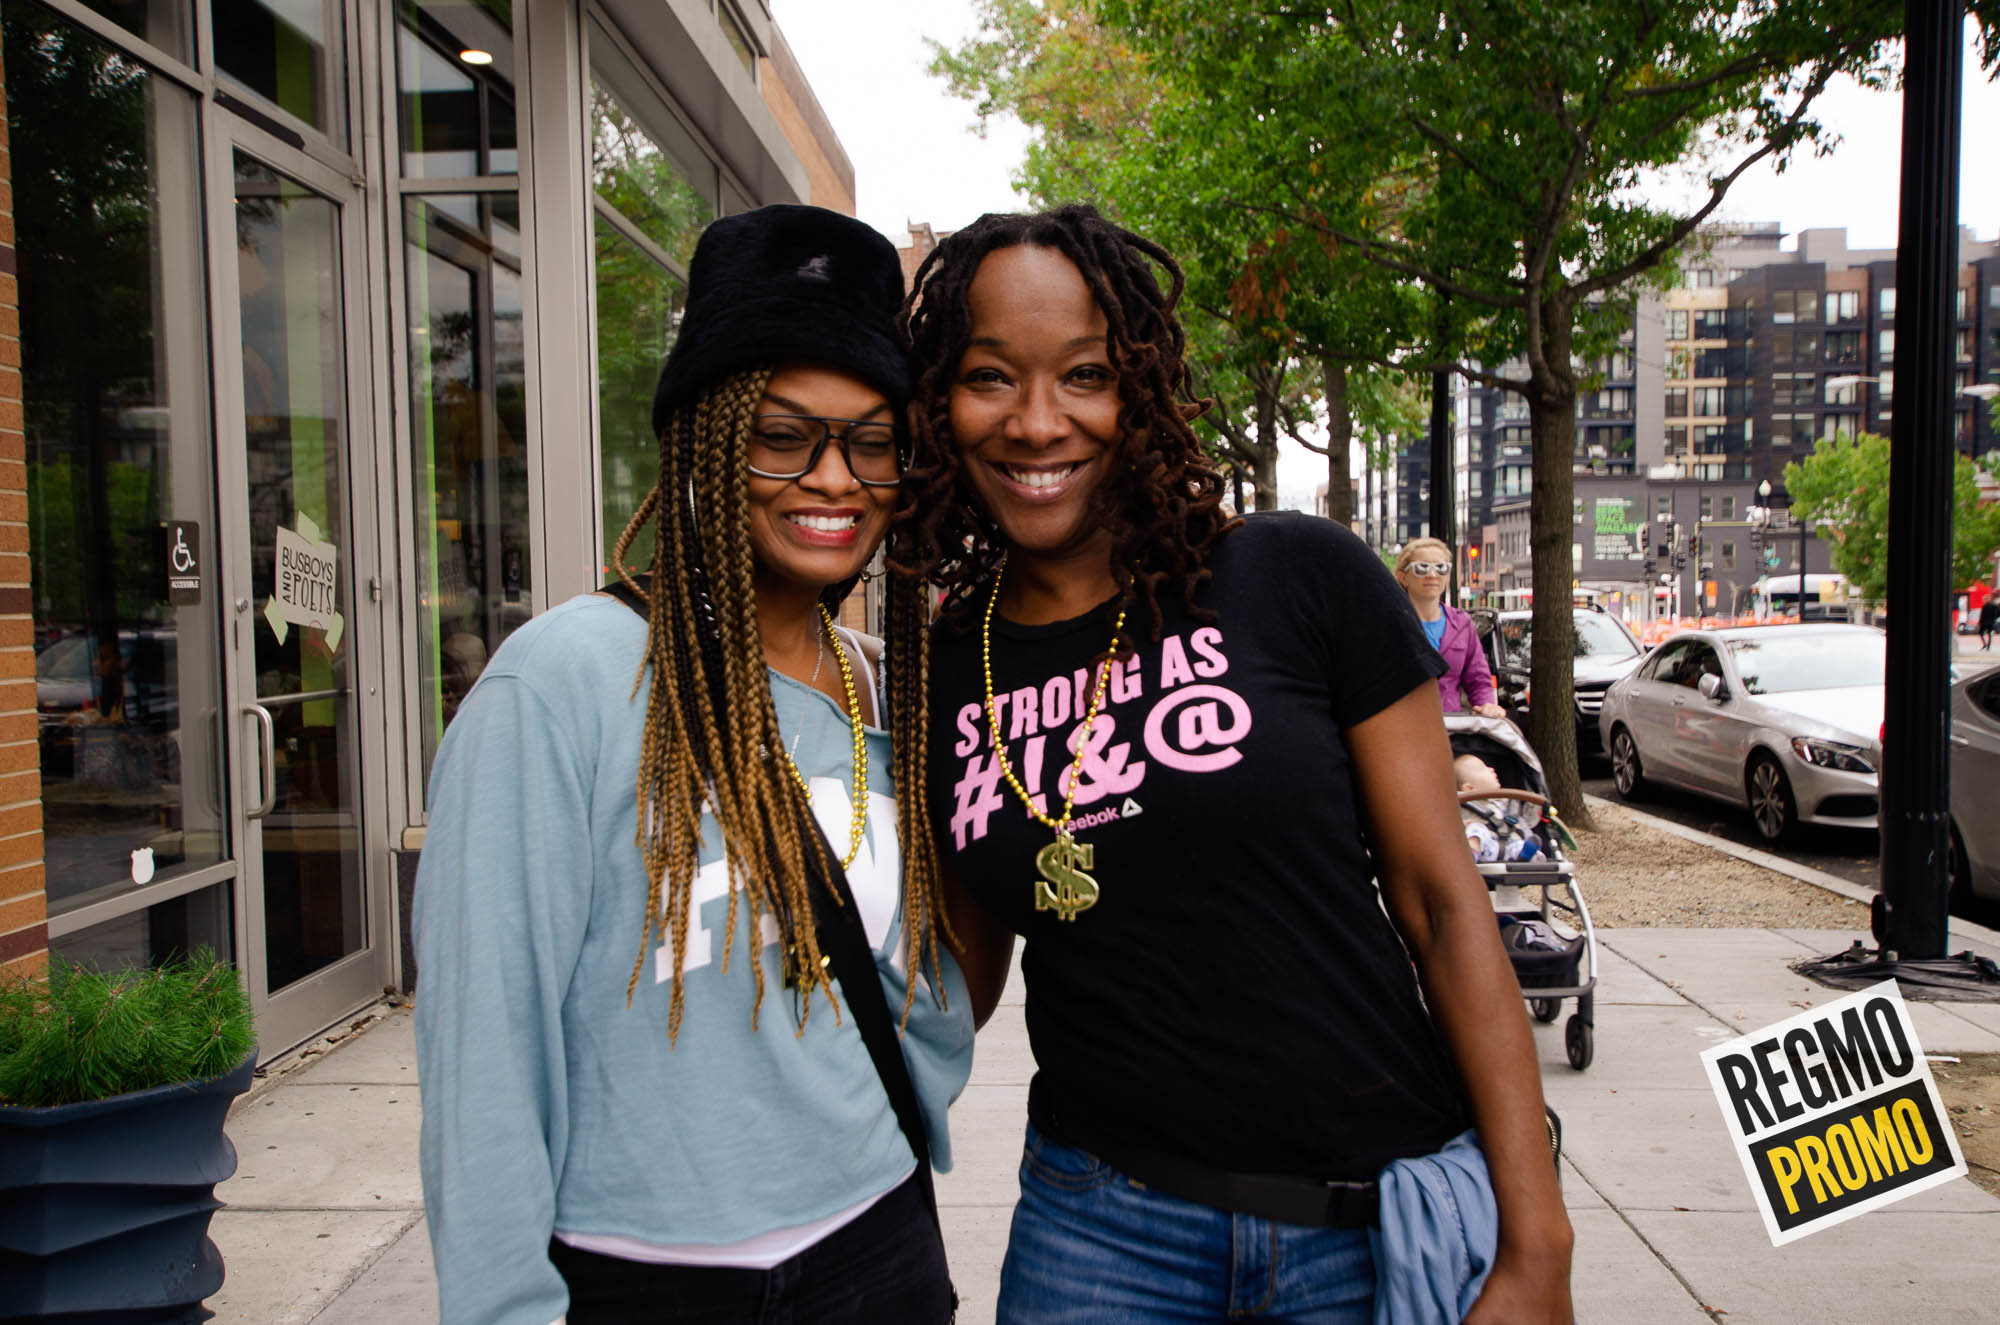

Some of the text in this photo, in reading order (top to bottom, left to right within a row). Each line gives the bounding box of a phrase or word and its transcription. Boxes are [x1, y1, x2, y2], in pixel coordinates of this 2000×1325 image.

[282, 546, 333, 582] BUSBOYS
[282, 570, 292, 604] AND
[292, 573, 333, 616] POETS
[1161, 627, 1229, 689] AS
